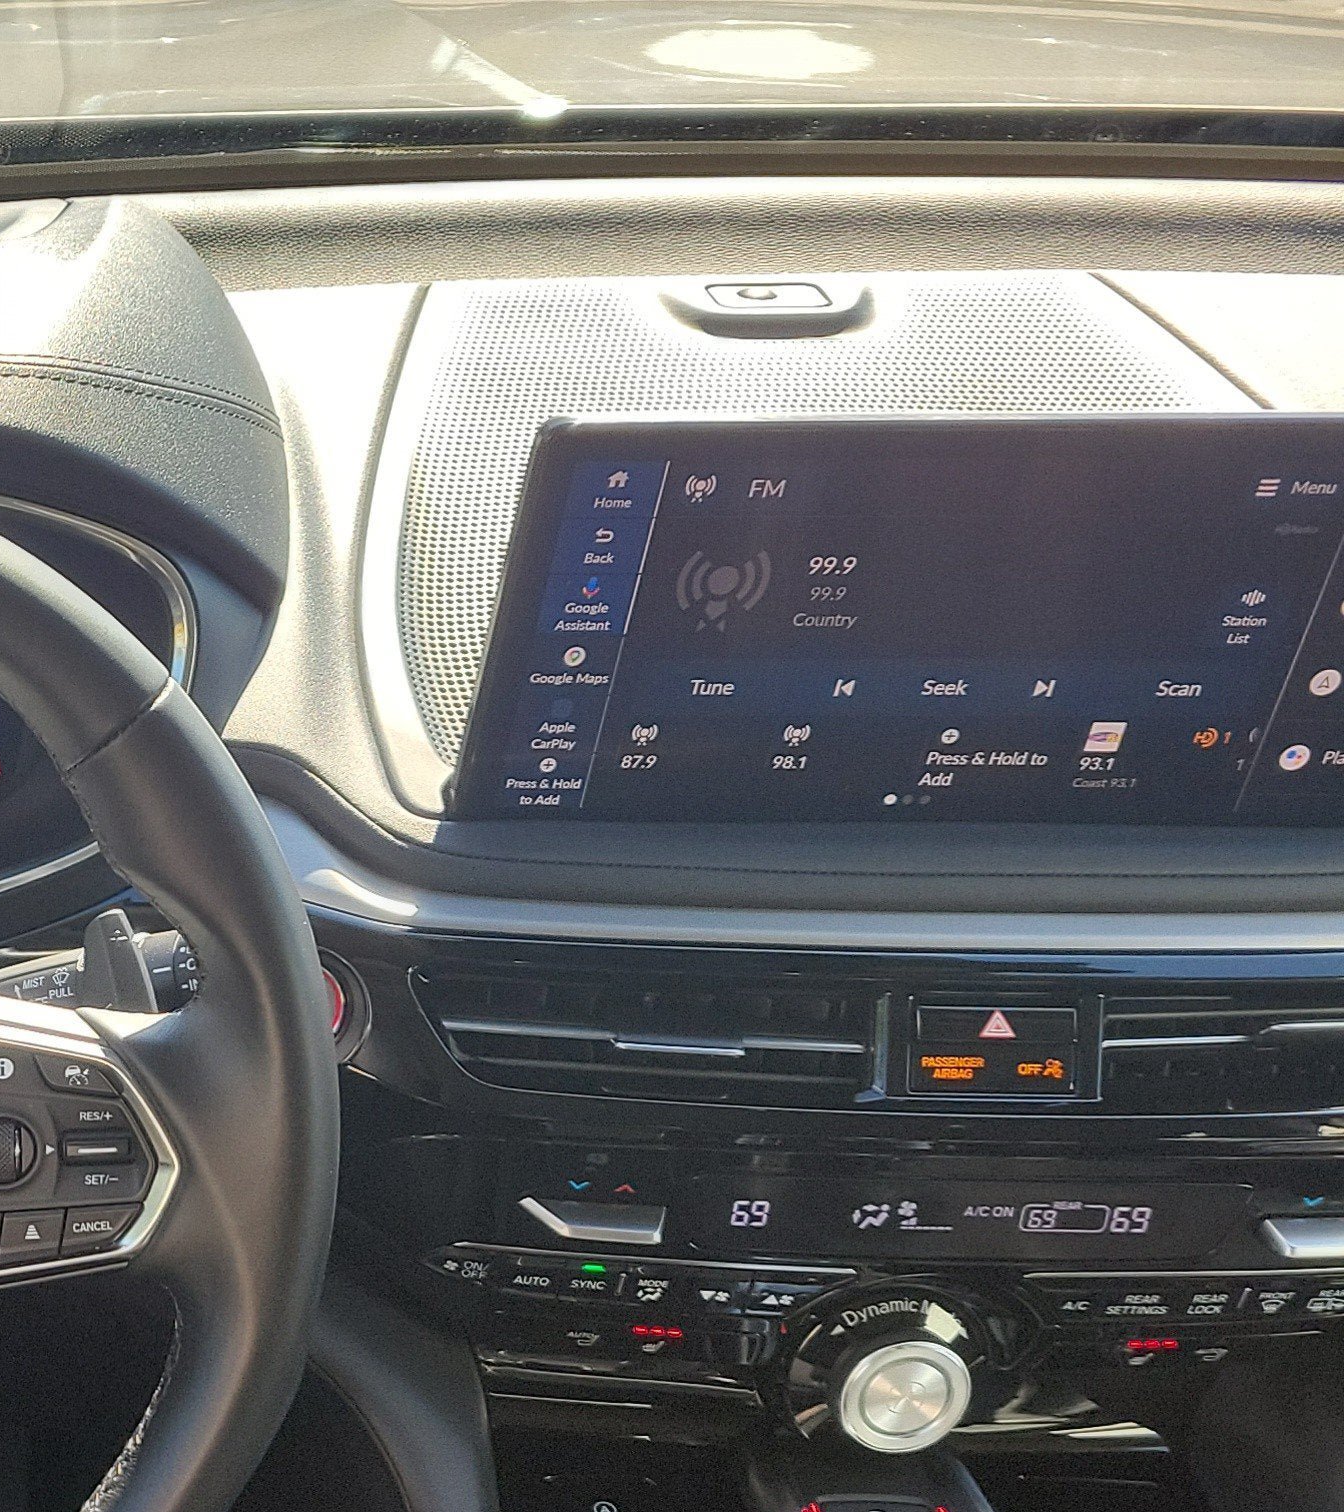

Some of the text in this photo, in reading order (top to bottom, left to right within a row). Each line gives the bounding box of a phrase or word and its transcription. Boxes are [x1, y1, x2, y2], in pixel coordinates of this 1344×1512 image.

[748, 480, 786, 498] FM
[1291, 481, 1337, 495] Menu
[593, 497, 632, 509] Home
[583, 552, 615, 565] Back
[808, 556, 858, 576] 99.9
[810, 586, 847, 602] 99.9
[564, 602, 609, 616] Google
[554, 619, 611, 632] Assistant
[792, 613, 858, 630] Country
[1221, 615, 1267, 627] Station
[1226, 632, 1251, 645] List
[529, 672, 609, 686] Google Maps
[690, 679, 736, 697] Tune
[921, 679, 969, 696] Seek
[1155, 680, 1202, 697] Scan
[539, 721, 576, 736] Apple
[531, 737, 576, 752] CarPlay
[620, 755, 658, 770] 87.9
[771, 755, 808, 770] 98.1
[925, 751, 1048, 766] Press & Hold to
[1079, 756, 1116, 771] 93.1
[505, 777, 582, 790] Press & Hold
[918, 772, 953, 787] Add
[519, 794, 560, 806] to Add
[22, 975, 46, 990] MIST
[48, 986, 75, 1000] PULL
[920, 1056, 985, 1068] PASSENGER
[1017, 1062, 1044, 1076] OFF
[932, 1067, 974, 1080] AIRBAG
[730, 1200, 771, 1228] 69
[964, 1205, 1015, 1218] A/C ON
[1027, 1209, 1058, 1229] 69
[1110, 1206, 1154, 1234] 69
[72, 1221, 113, 1234] CANCEL
[461, 1269, 488, 1280] OFF
[513, 1275, 550, 1287] AUTO
[570, 1279, 608, 1291] SYNC
[637, 1278, 670, 1289] MODE
[1124, 1294, 1161, 1304] REAR
[1191, 1293, 1230, 1304] REAR
[840, 1296, 920, 1329] Dynamic
[1061, 1301, 1091, 1311] A/C
[1105, 1305, 1170, 1315] SETTINGS
[1185, 1304, 1224, 1315] LOCK
